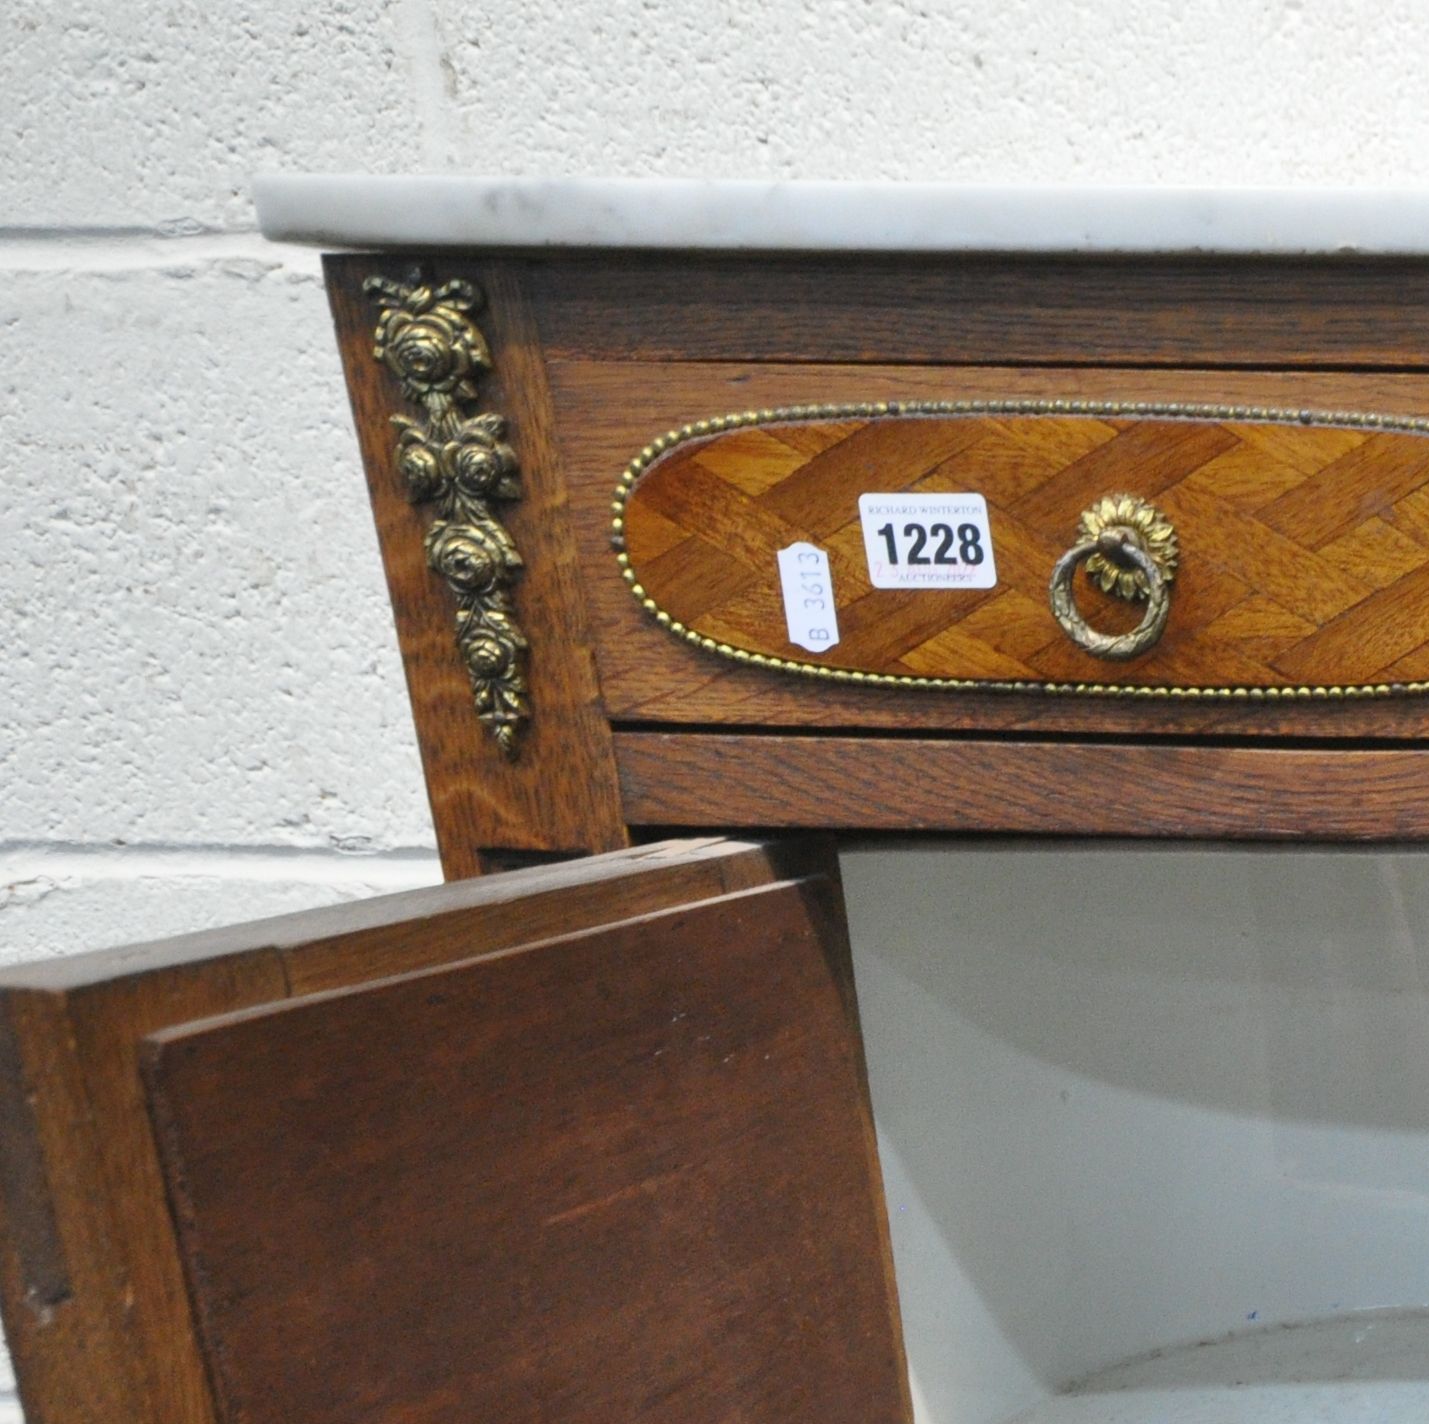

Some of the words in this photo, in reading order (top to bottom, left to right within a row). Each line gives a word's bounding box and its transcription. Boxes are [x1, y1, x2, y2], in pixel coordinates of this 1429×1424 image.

[868, 505, 917, 515] RICHARD
[920, 505, 982, 515] WINTERTON
[877, 523, 984, 565] 1228
[797, 553, 825, 610] 3613
[808, 628, 830, 641] B
